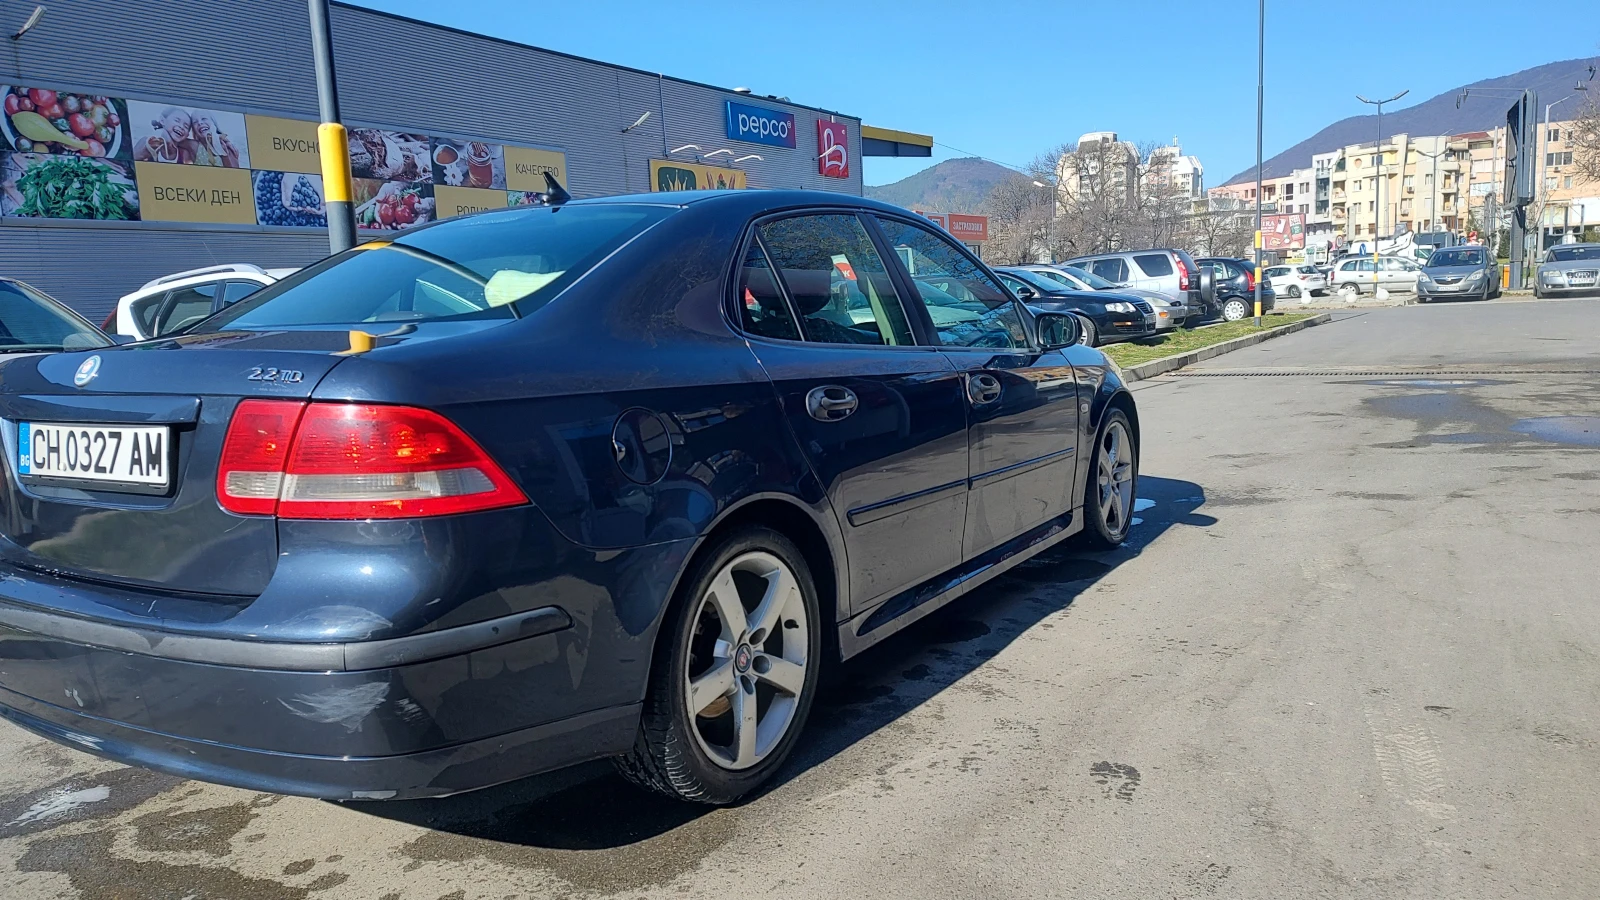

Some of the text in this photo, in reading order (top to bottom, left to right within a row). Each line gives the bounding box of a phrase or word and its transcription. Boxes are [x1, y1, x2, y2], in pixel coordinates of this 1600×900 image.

[738, 113, 788, 138] pepco
[272, 137, 321, 154] ВКУСН
[515, 163, 559, 178] КАЧЕСТВО
[153, 186, 241, 206] ВСЕКИ ДЕН
[20, 454, 30, 466] BG
[129, 432, 162, 477] AM
